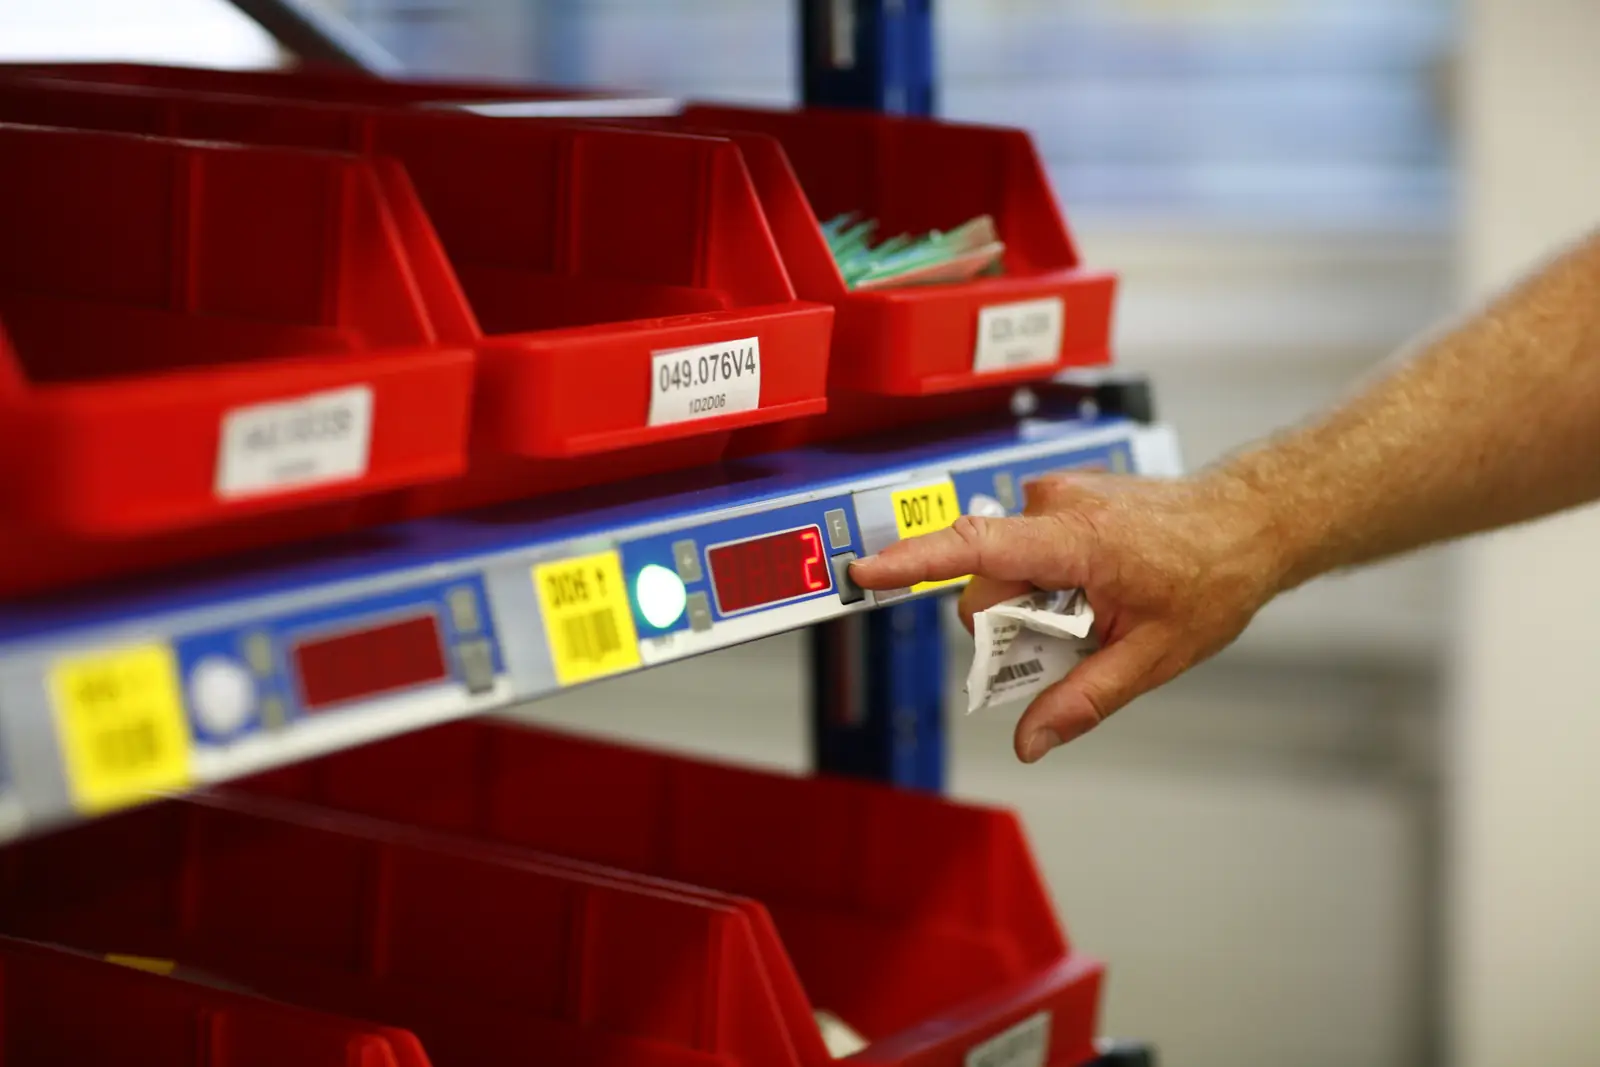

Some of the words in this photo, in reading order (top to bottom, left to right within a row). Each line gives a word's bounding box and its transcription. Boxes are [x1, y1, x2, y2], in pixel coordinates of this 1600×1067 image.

[659, 347, 756, 392] 049.076V4
[689, 393, 726, 414] 1D2D06
[833, 519, 842, 537] F
[900, 495, 930, 528] D07
[801, 531, 823, 590] 2
